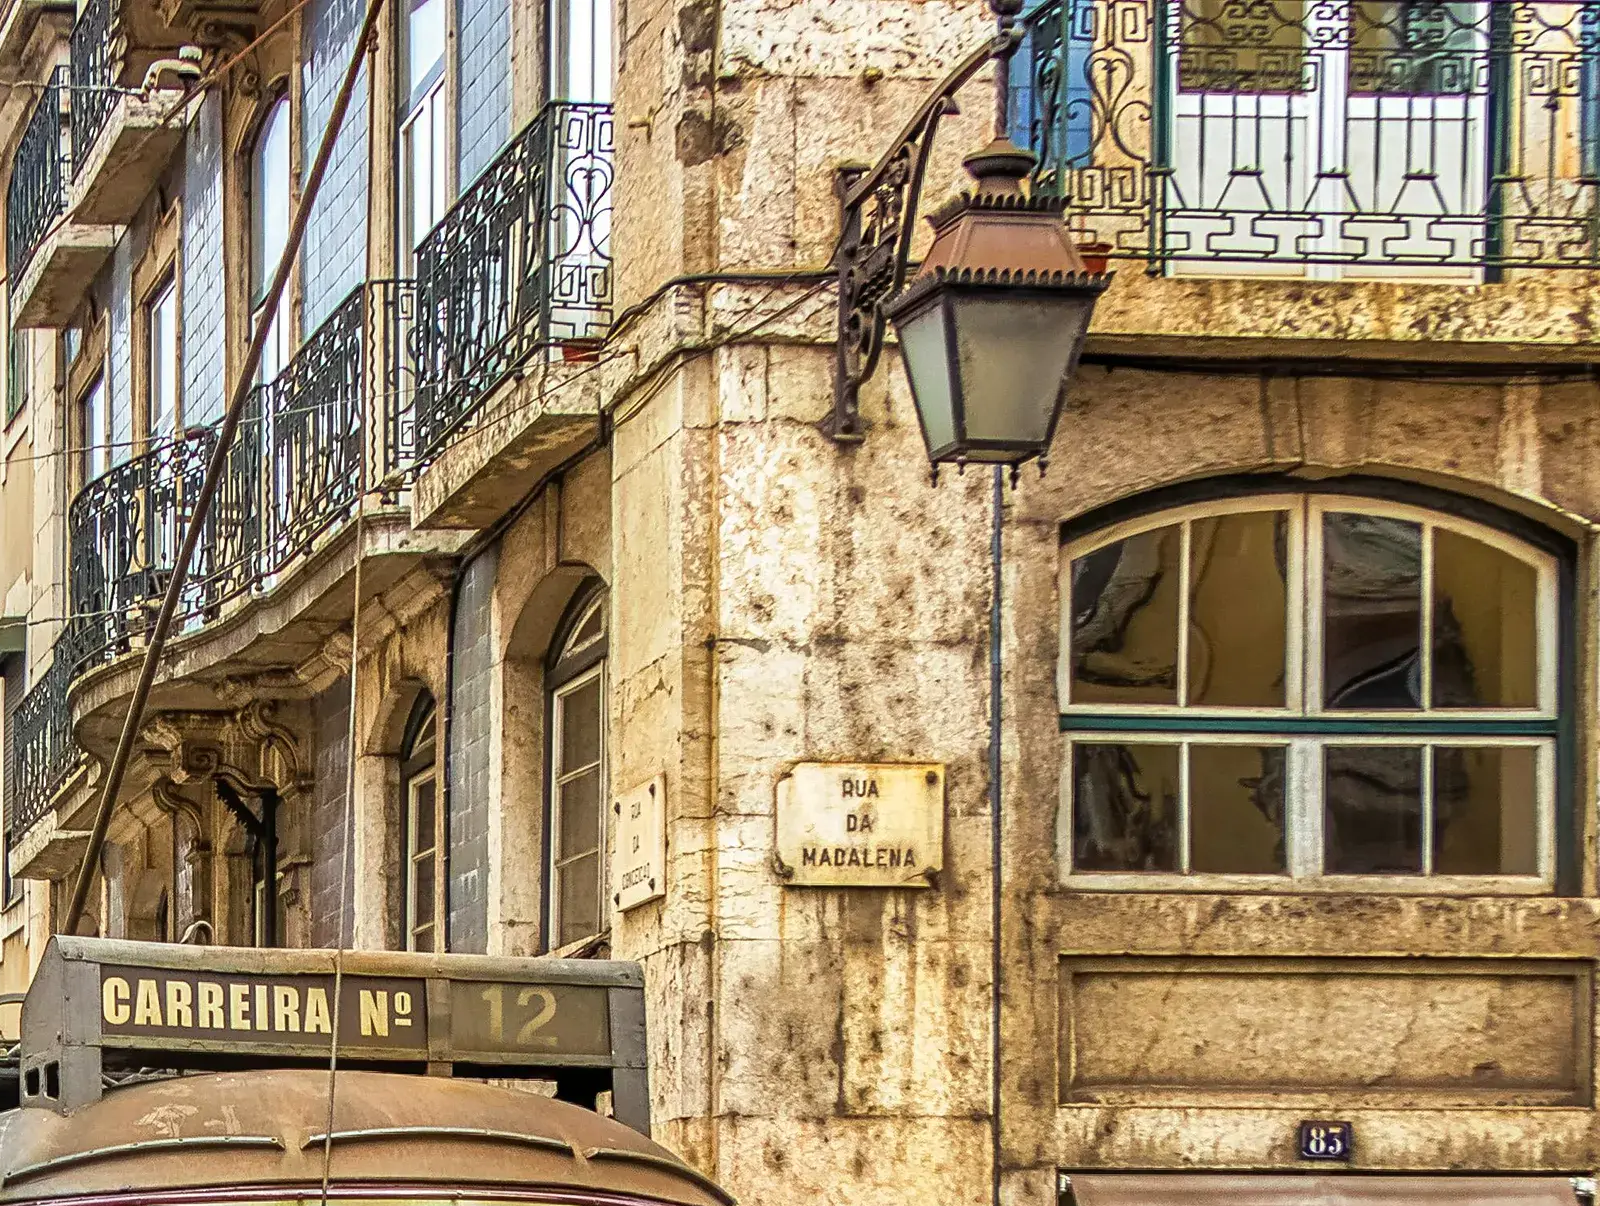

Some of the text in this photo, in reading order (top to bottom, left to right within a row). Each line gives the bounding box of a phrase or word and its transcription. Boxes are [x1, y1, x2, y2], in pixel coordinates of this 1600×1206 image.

[842, 779, 879, 798] RUA
[846, 814, 873, 833] DA
[802, 847, 916, 867] MADALENA
[102, 976, 333, 1034] CARREIRA
[481, 985, 558, 1047] 12
